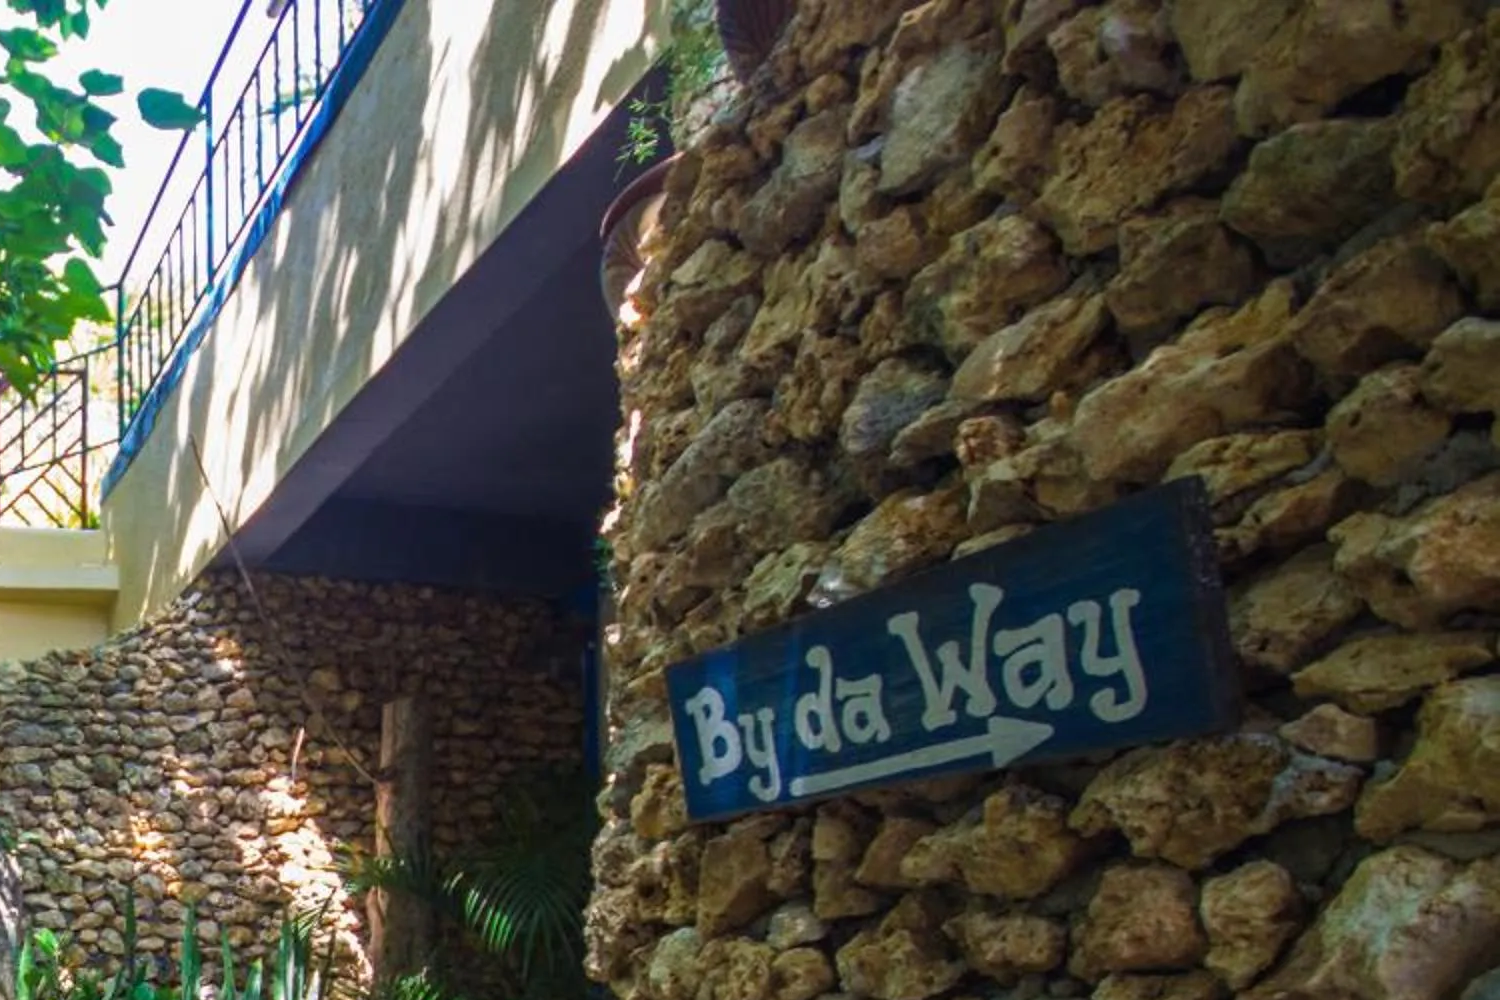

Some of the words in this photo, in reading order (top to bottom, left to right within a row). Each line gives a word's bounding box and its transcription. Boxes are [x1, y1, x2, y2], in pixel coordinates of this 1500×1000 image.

[685, 686, 782, 802] By
[794, 645, 891, 753] da
[887, 582, 1148, 732] Way
